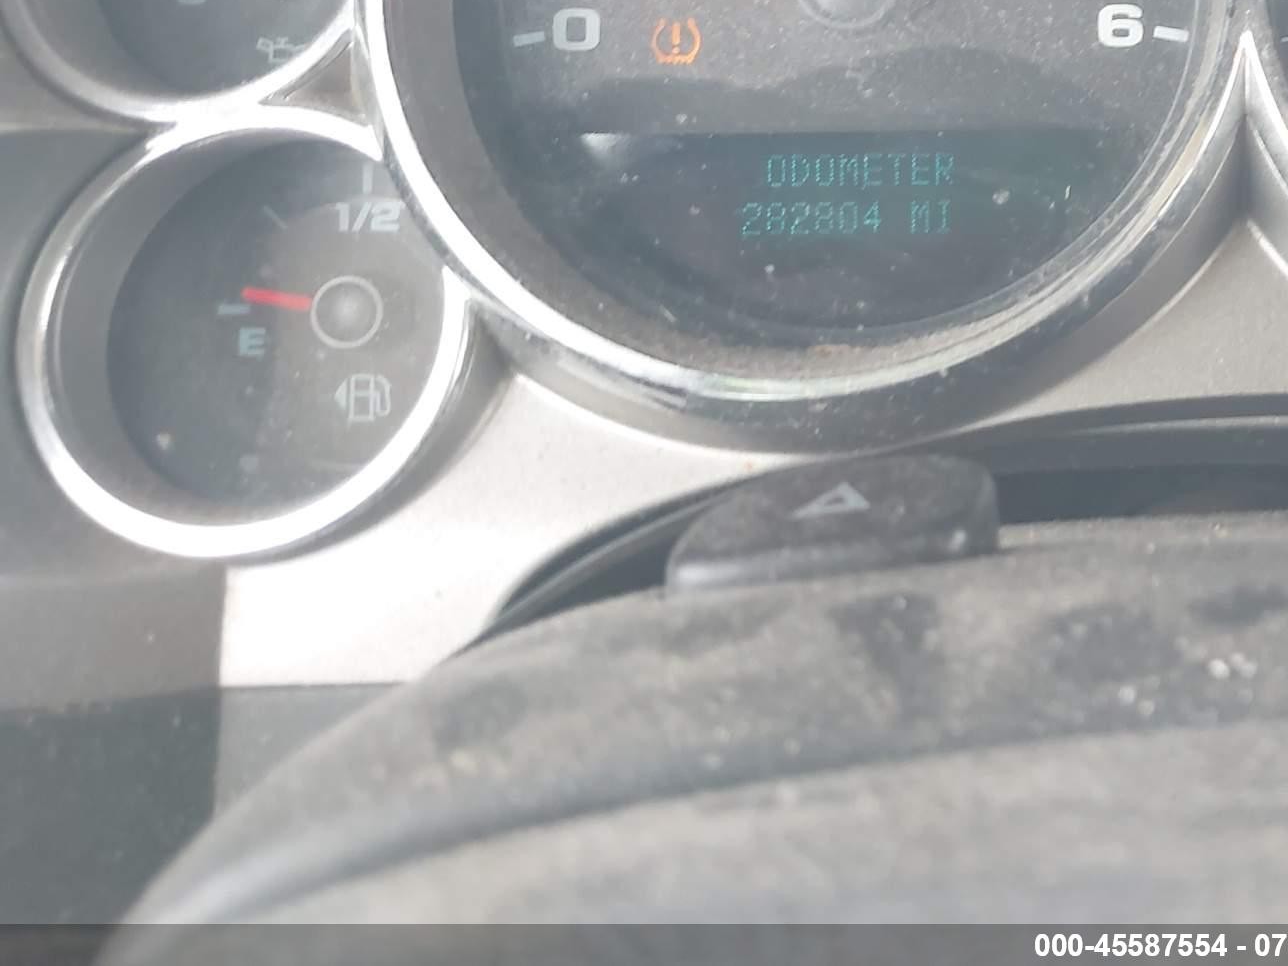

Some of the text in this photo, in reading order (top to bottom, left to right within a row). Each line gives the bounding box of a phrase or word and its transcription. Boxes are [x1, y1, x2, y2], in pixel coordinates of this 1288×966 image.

[552, 8, 601, 51] 0
[1098, 4, 1144, 46] 6
[767, 154, 954, 187] ODOMETER
[335, 202, 402, 232] 1/2
[741, 200, 952, 235] 282804 MI
[239, 328, 266, 357] E
